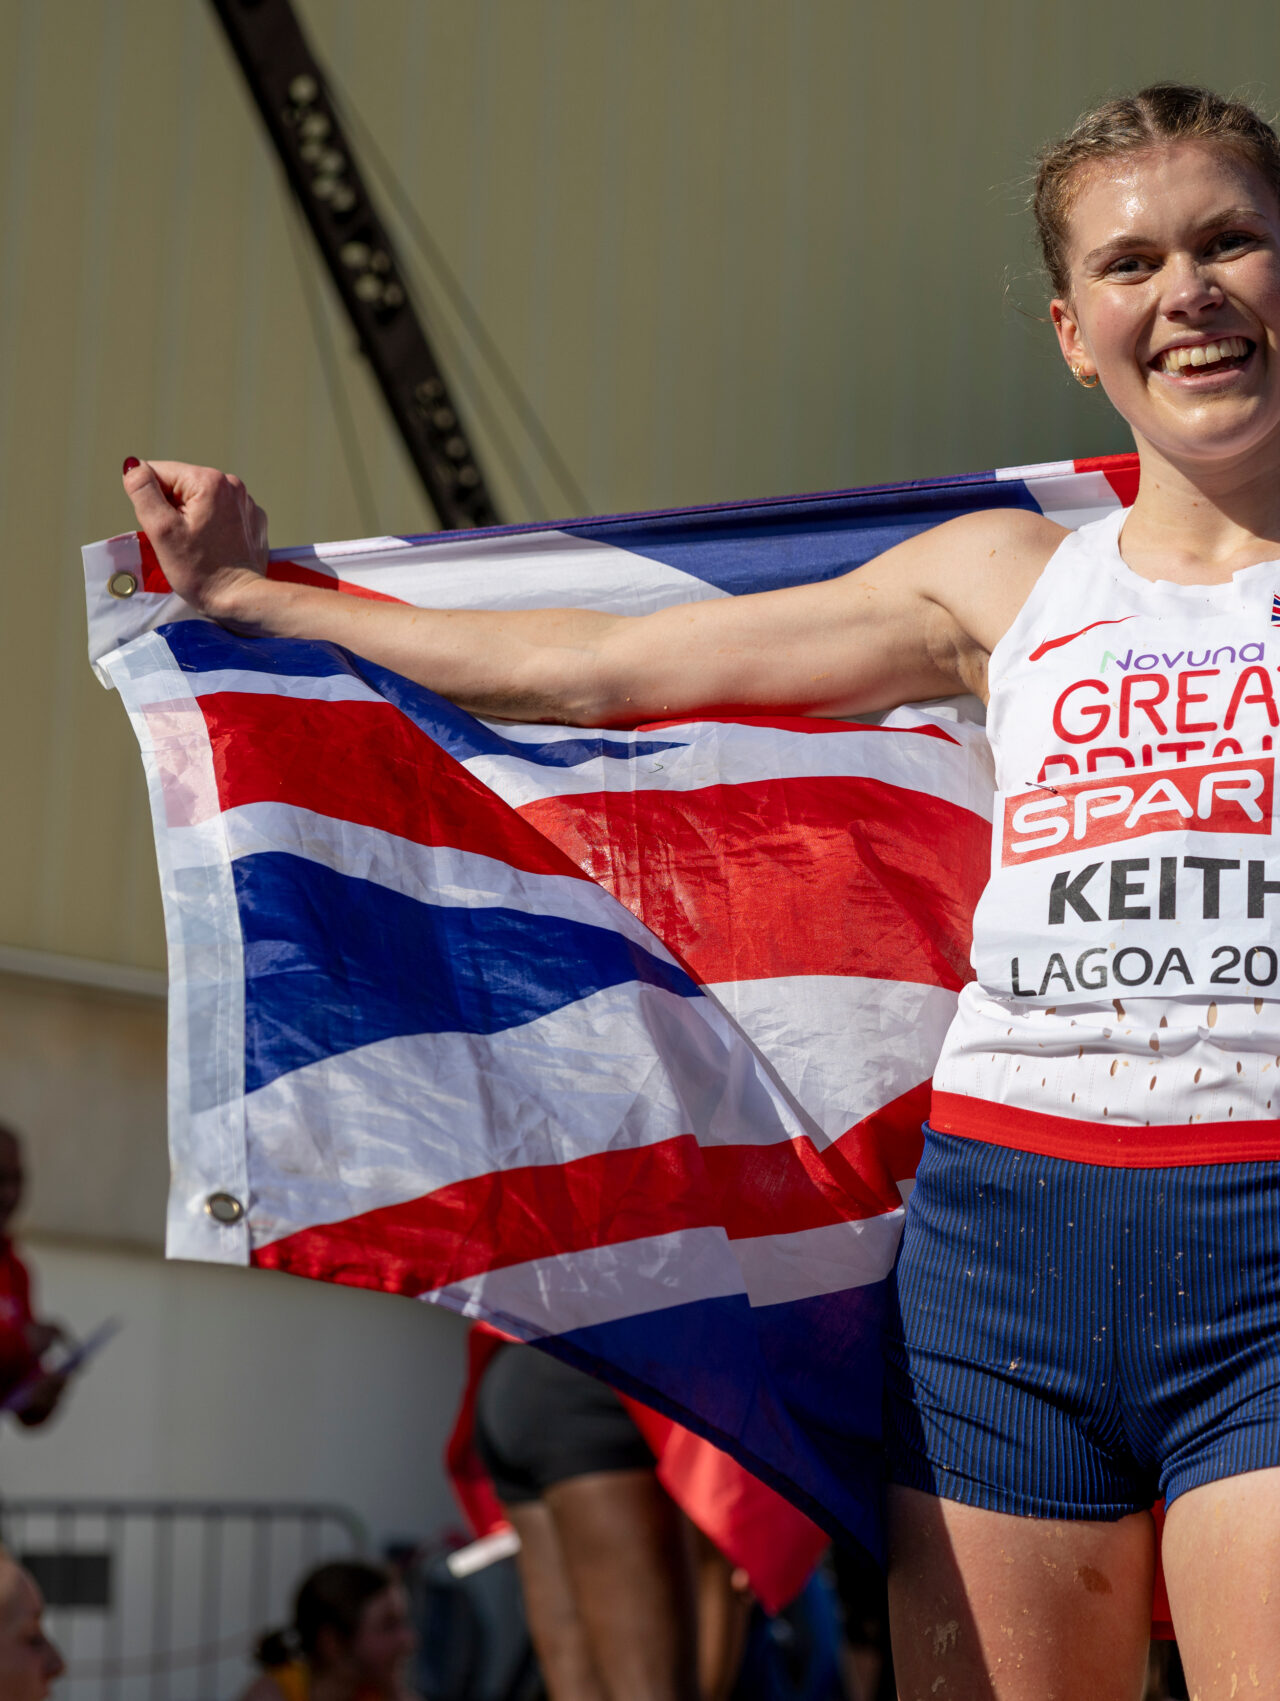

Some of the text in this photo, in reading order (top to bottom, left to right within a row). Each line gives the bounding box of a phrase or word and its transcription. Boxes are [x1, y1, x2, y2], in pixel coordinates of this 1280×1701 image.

[1100, 641, 1265, 674] Novuna
[1010, 769, 1265, 854] SPAR
[1010, 947, 1195, 998] LAGOA
